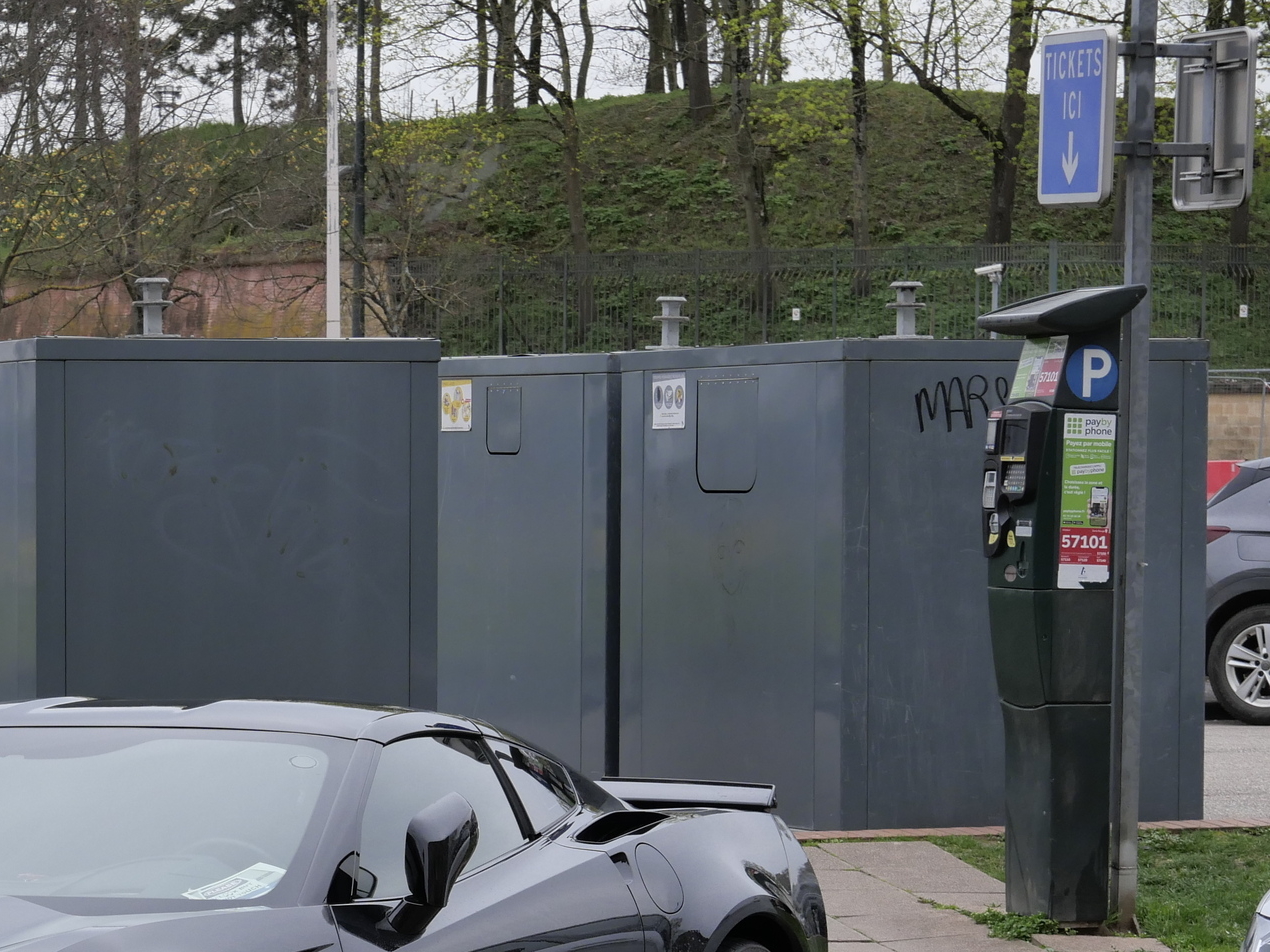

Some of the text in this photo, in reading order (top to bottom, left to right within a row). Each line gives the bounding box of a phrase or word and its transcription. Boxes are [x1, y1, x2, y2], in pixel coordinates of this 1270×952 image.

[1045, 47, 1103, 81] TICKETS
[1062, 90, 1082, 119] ICI
[1038, 371, 1059, 383] 57101
[1082, 348, 1112, 398] P
[1084, 427, 1112, 436] phone
[1061, 534, 1108, 549] 57101
